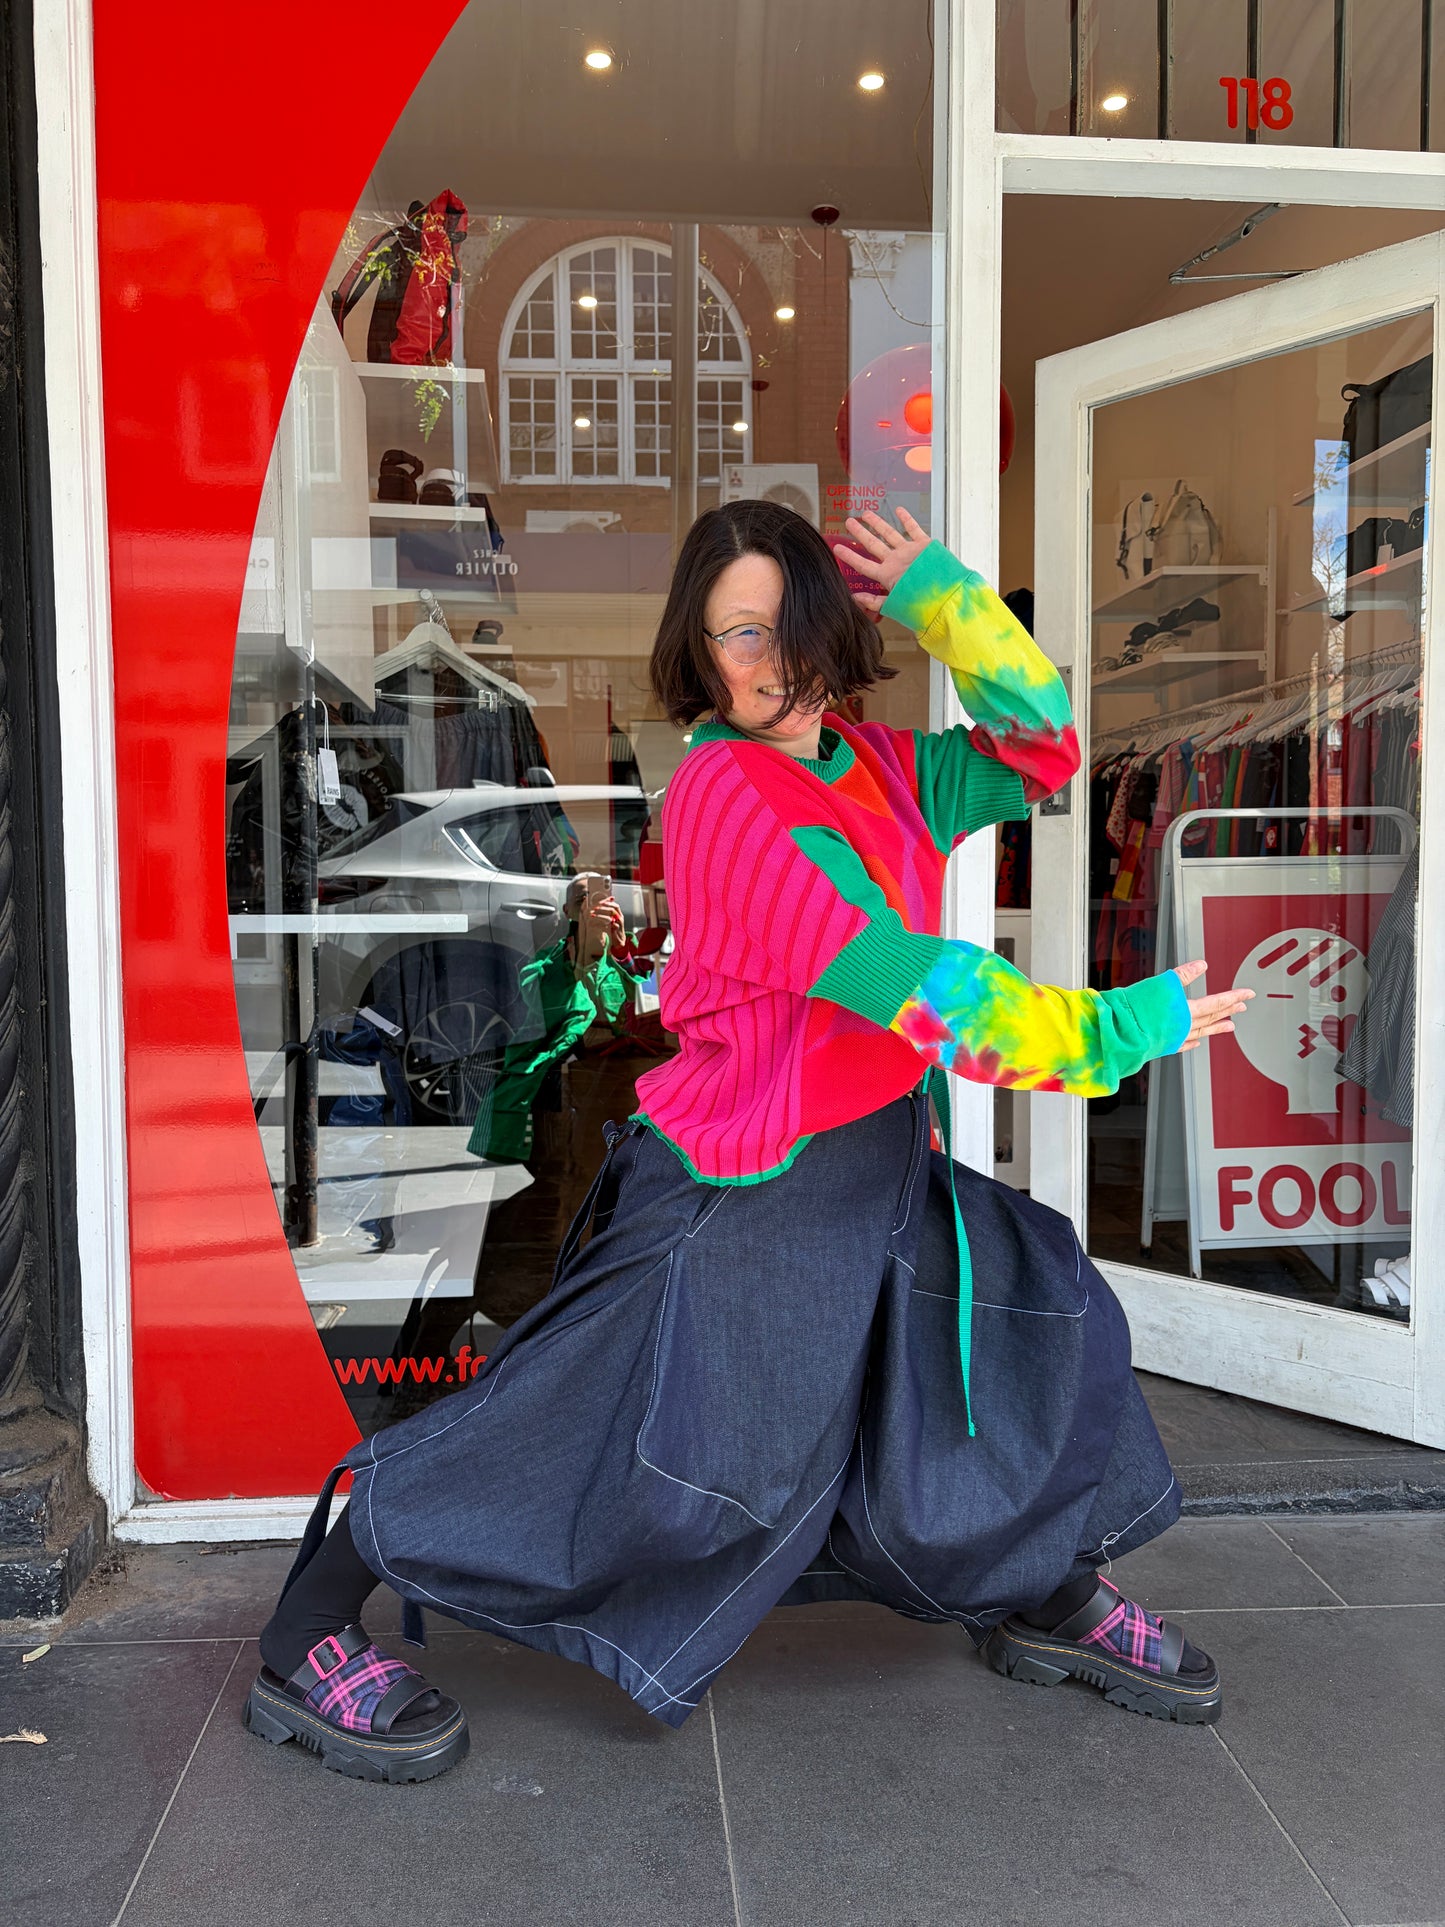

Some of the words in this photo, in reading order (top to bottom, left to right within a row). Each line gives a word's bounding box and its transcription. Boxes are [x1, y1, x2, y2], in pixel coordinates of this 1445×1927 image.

[1219, 77, 1294, 131] 118
[827, 485, 886, 498] OPENING
[832, 499, 879, 511] HOURS
[1217, 1160, 1412, 1232] FOOL
